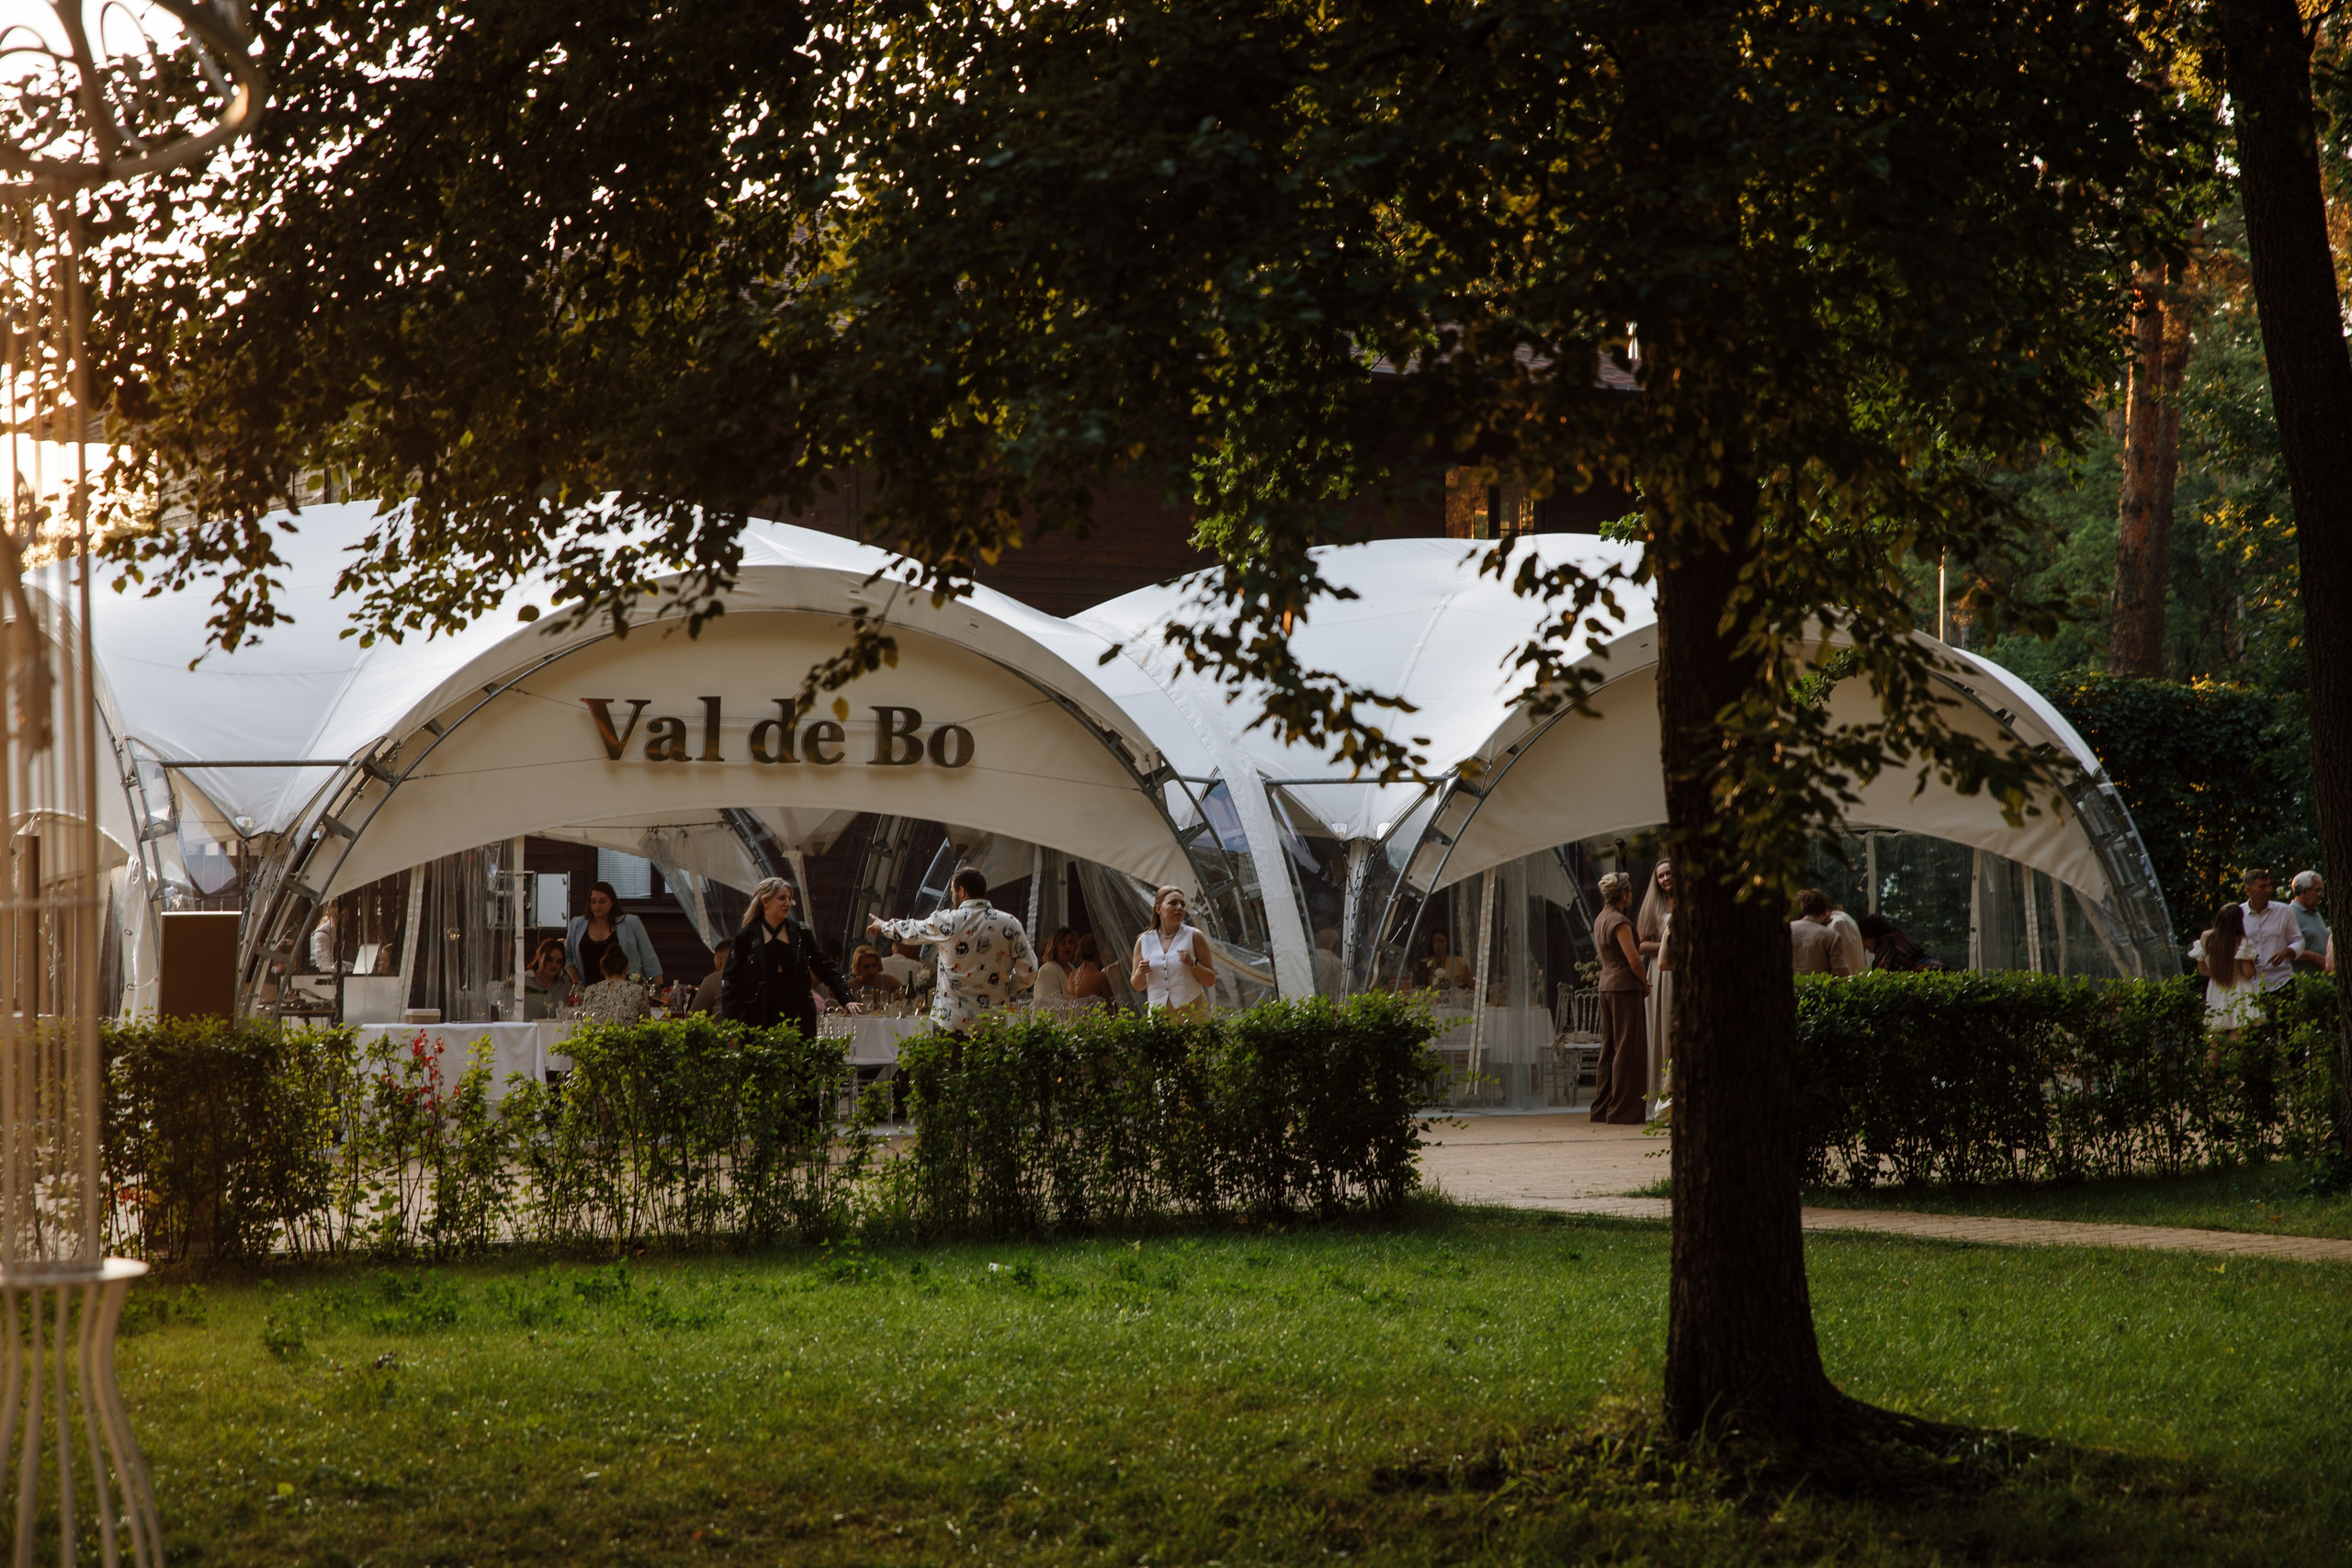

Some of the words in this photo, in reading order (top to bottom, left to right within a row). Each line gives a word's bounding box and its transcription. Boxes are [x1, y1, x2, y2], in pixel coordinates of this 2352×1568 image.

[580, 695, 725, 761] Val
[748, 698, 846, 765] de
[866, 705, 975, 769] Bo
